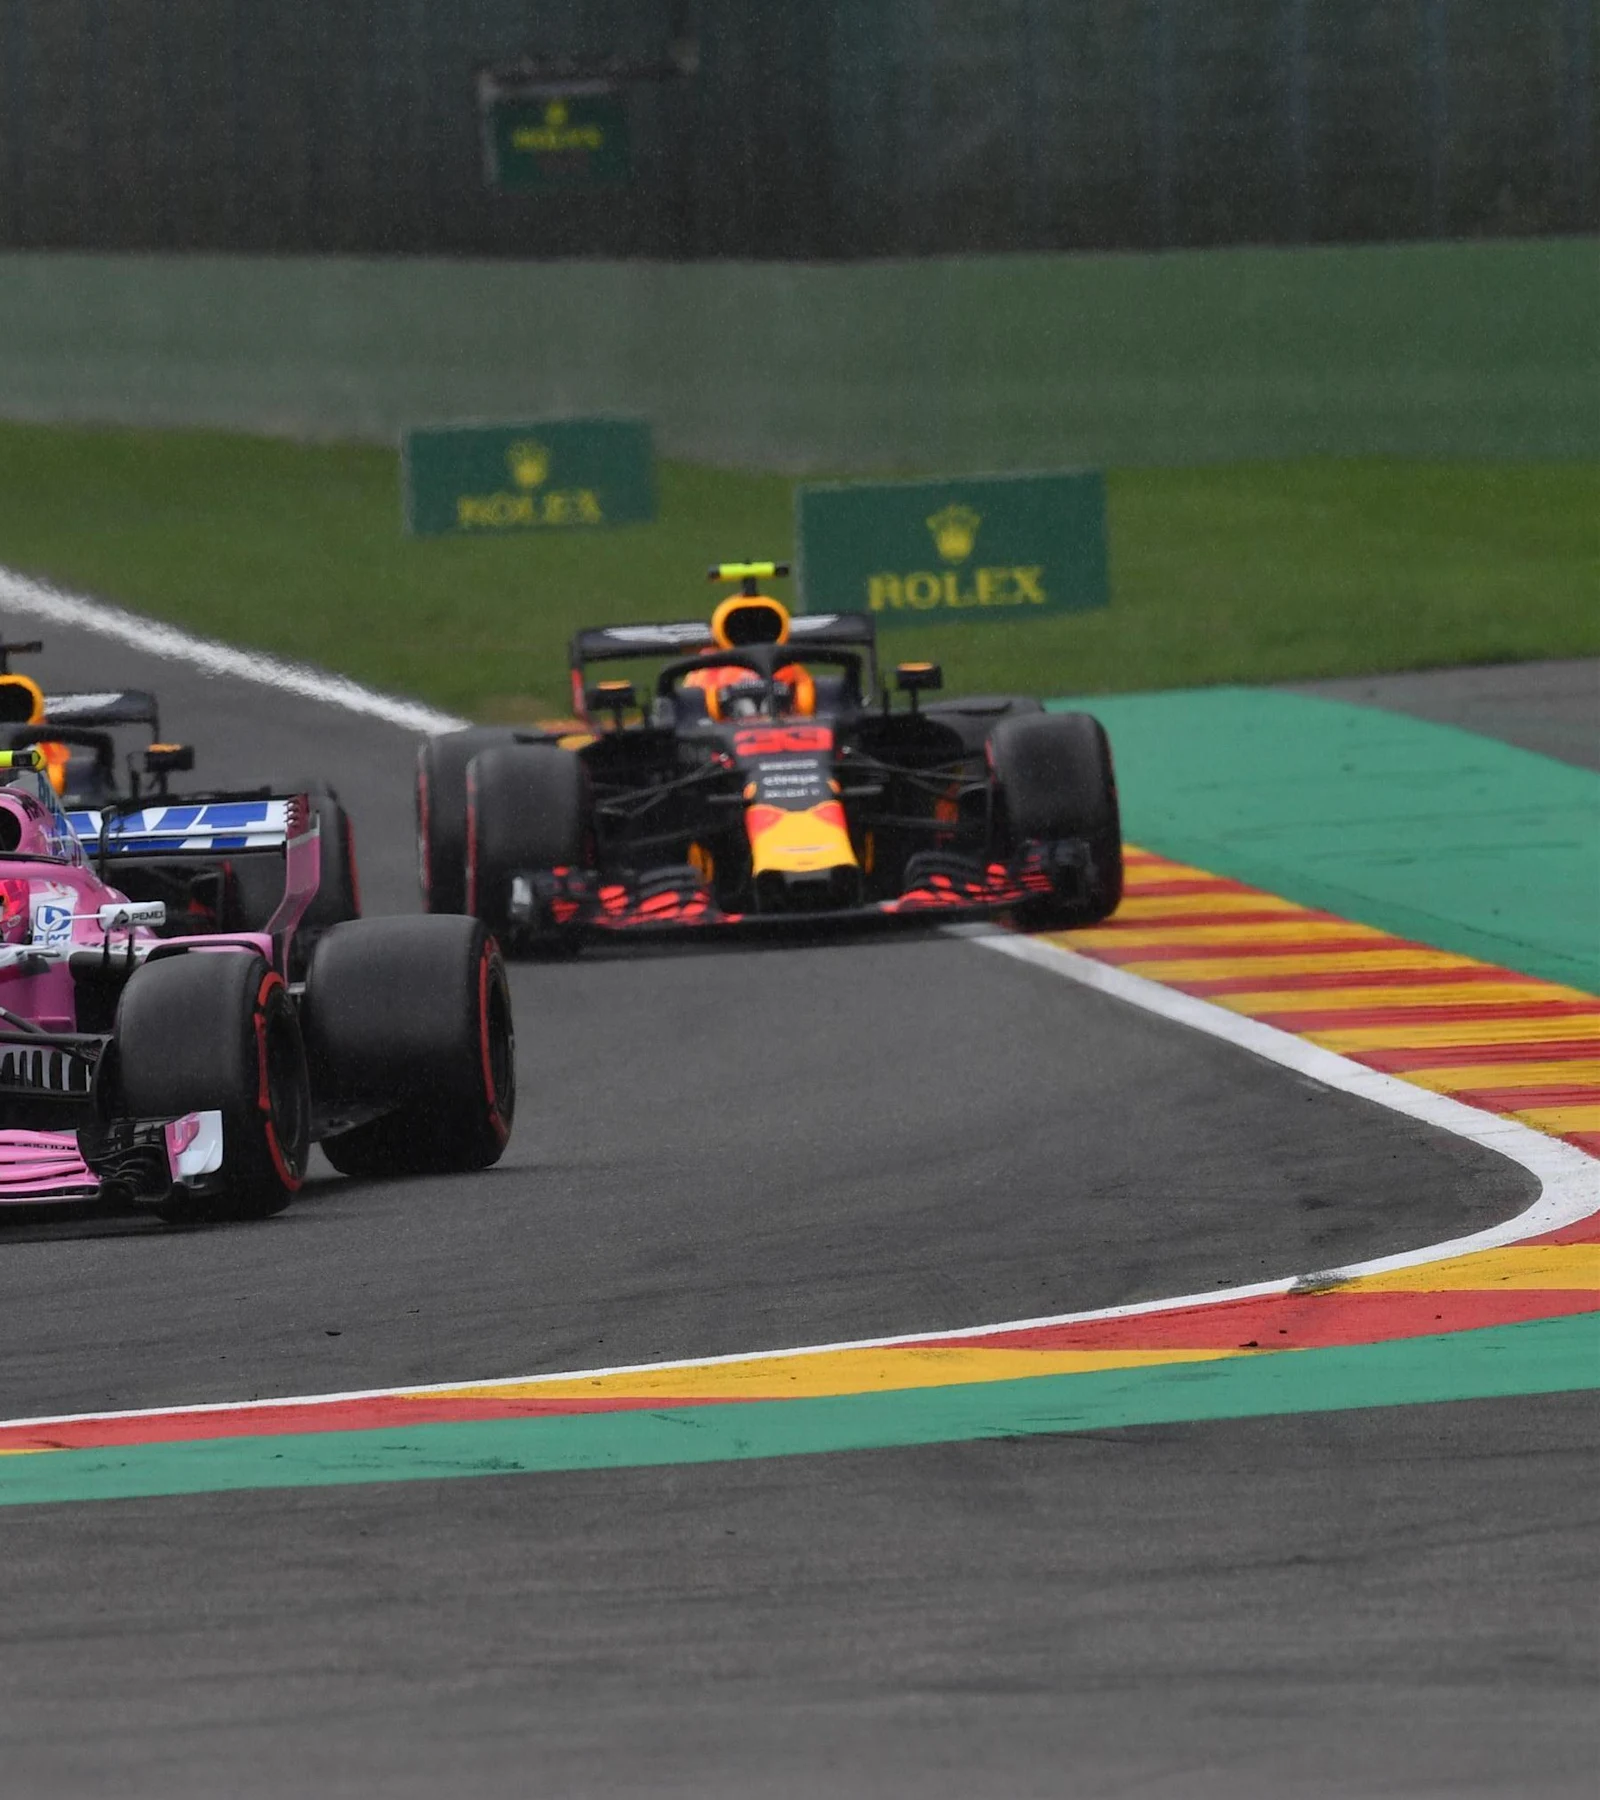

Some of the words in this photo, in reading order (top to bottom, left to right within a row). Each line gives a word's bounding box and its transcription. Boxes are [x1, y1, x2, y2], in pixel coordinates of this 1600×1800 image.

[866, 566, 1046, 611] ROLEX
[733, 725, 834, 756] 33
[132, 910, 164, 921] PEMEX
